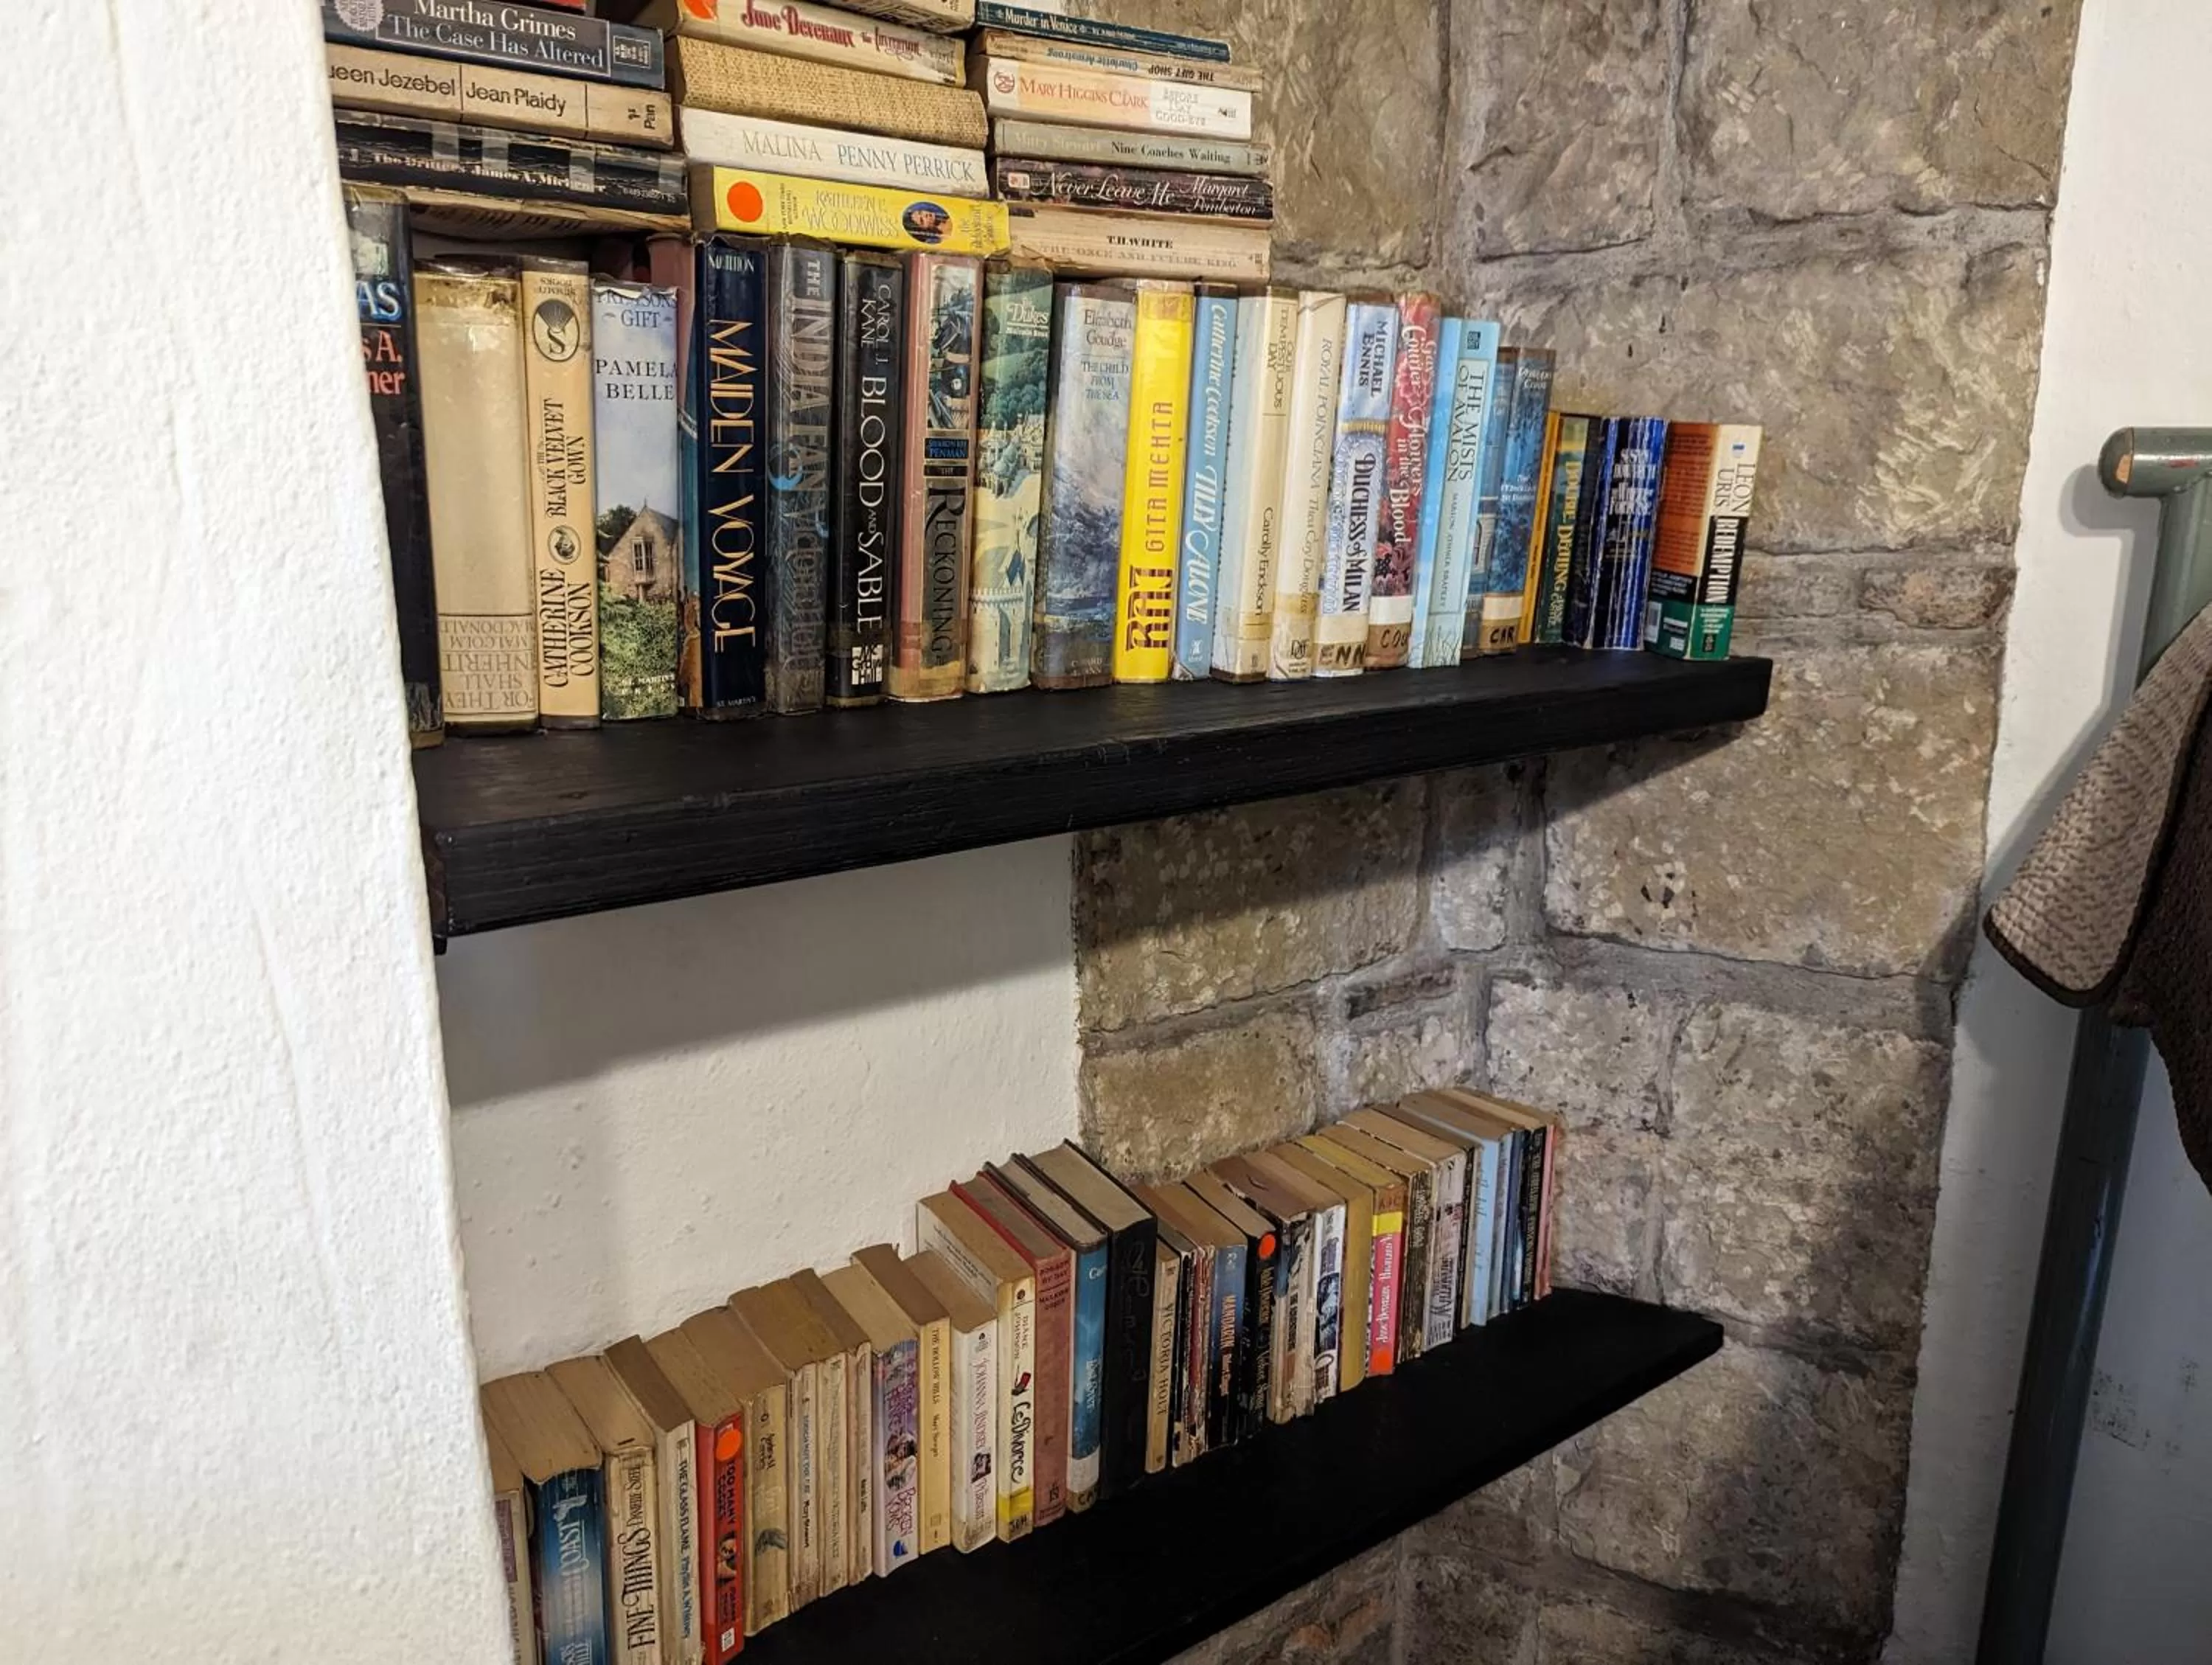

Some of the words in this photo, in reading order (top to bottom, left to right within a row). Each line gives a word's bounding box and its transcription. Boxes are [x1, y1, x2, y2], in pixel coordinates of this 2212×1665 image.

[388, 14, 431, 40] The
[442, 23, 485, 49] Case
[490, 32, 529, 55] Has
[536, 40, 604, 68] Altered
[414, 0, 495, 28] Martha
[501, 6, 577, 40] Grimes
[1004, 7, 1038, 27] Murder
[1040, 16, 1049, 28] in
[1050, 15, 1078, 33] Venice
[1096, 55, 1138, 72] Charlotte
[1147, 63, 1172, 77] SHOP
[1175, 68, 1195, 80] GIFT
[1197, 70, 1215, 82] THE
[379, 69, 456, 96] Jezebel
[466, 83, 511, 105] Jean
[515, 88, 567, 117] Plaidy
[644, 105, 656, 130] Pan
[742, 129, 823, 162] MALINA
[837, 144, 898, 172] PENNY
[903, 153, 977, 183] PERRICK
[1111, 141, 1138, 155] Nine
[1141, 144, 1184, 159] Coaches
[1189, 148, 1231, 166] Waiting
[1032, 175, 1090, 197] Never
[1095, 174, 1147, 206] Leave
[1145, 183, 1175, 206] Me
[1180, 177, 1249, 195] Margaret
[1186, 195, 1256, 215] Pemberton
[806, 260, 821, 296] THE
[621, 310, 660, 328] GIFT
[860, 298, 876, 348] KANE
[875, 284, 892, 349] CAROL
[1084, 309, 1132, 330] Elizabeth
[596, 359, 678, 379] PAMELA
[790, 297, 832, 412] INDIA
[1209, 304, 1228, 386] Catherine
[1267, 342, 1278, 372] DAY
[1273, 306, 1290, 409] TEMPESTUOUS
[1318, 338, 1333, 393] ROYAL
[1359, 332, 1376, 387] ENNIS
[1369, 320, 1388, 398] MICHAEL
[606, 383, 675, 401] BELLE
[708, 319, 759, 473] MAIDEN
[1457, 365, 1470, 389] OF
[1467, 373, 1484, 413] THE
[543, 399, 566, 465] VELVET
[859, 377, 887, 507] BLOOD
[1148, 402, 1173, 487] MEHTA
[1203, 386, 1222, 456] Cookson
[1309, 394, 1329, 489] POINCIANA
[1447, 399, 1466, 482] AVALON
[567, 436, 586, 484] GOWN
[1399, 407, 1428, 497] Flowers
[1399, 456, 1409, 479] the
[1458, 423, 1478, 480] MISTS
[546, 469, 568, 518] BLACK
[1193, 465, 1218, 532] TILLY
[1349, 452, 1377, 542] DUCHESS
[1388, 483, 1411, 543] Blood
[1715, 468, 1735, 508] URIS
[1733, 463, 1756, 513] LEON
[867, 508, 877, 534] AND
[1145, 498, 1167, 553] GITA
[1258, 507, 1273, 558] Carolly
[708, 494, 756, 653] VOYAGE
[925, 487, 967, 653] RECKONING
[1346, 542, 1367, 558] of
[1704, 518, 1739, 604] REDEMPTION
[857, 531, 883, 633] SABLE
[1185, 529, 1211, 625] ALONE
[1254, 560, 1270, 616] Erickson
[1343, 558, 1370, 613] MILAN
[540, 568, 568, 687] CATHERINE
[568, 583, 595, 677] COOKSON
[1125, 565, 1173, 652] RAJ
[450, 635, 528, 650] MALCOLM
[445, 691, 501, 709] THEY
[460, 673, 524, 689] SHALL
[503, 691, 536, 708] FOR
[1158, 1302, 1175, 1374] VICTORIA
[1155, 1378, 1169, 1416] HOLT
[679, 1483, 690, 1518] GLASS
[680, 1518, 692, 1553] FLAME
[616, 1526, 654, 1607] THINGS
[626, 1603, 656, 1650] FINE
